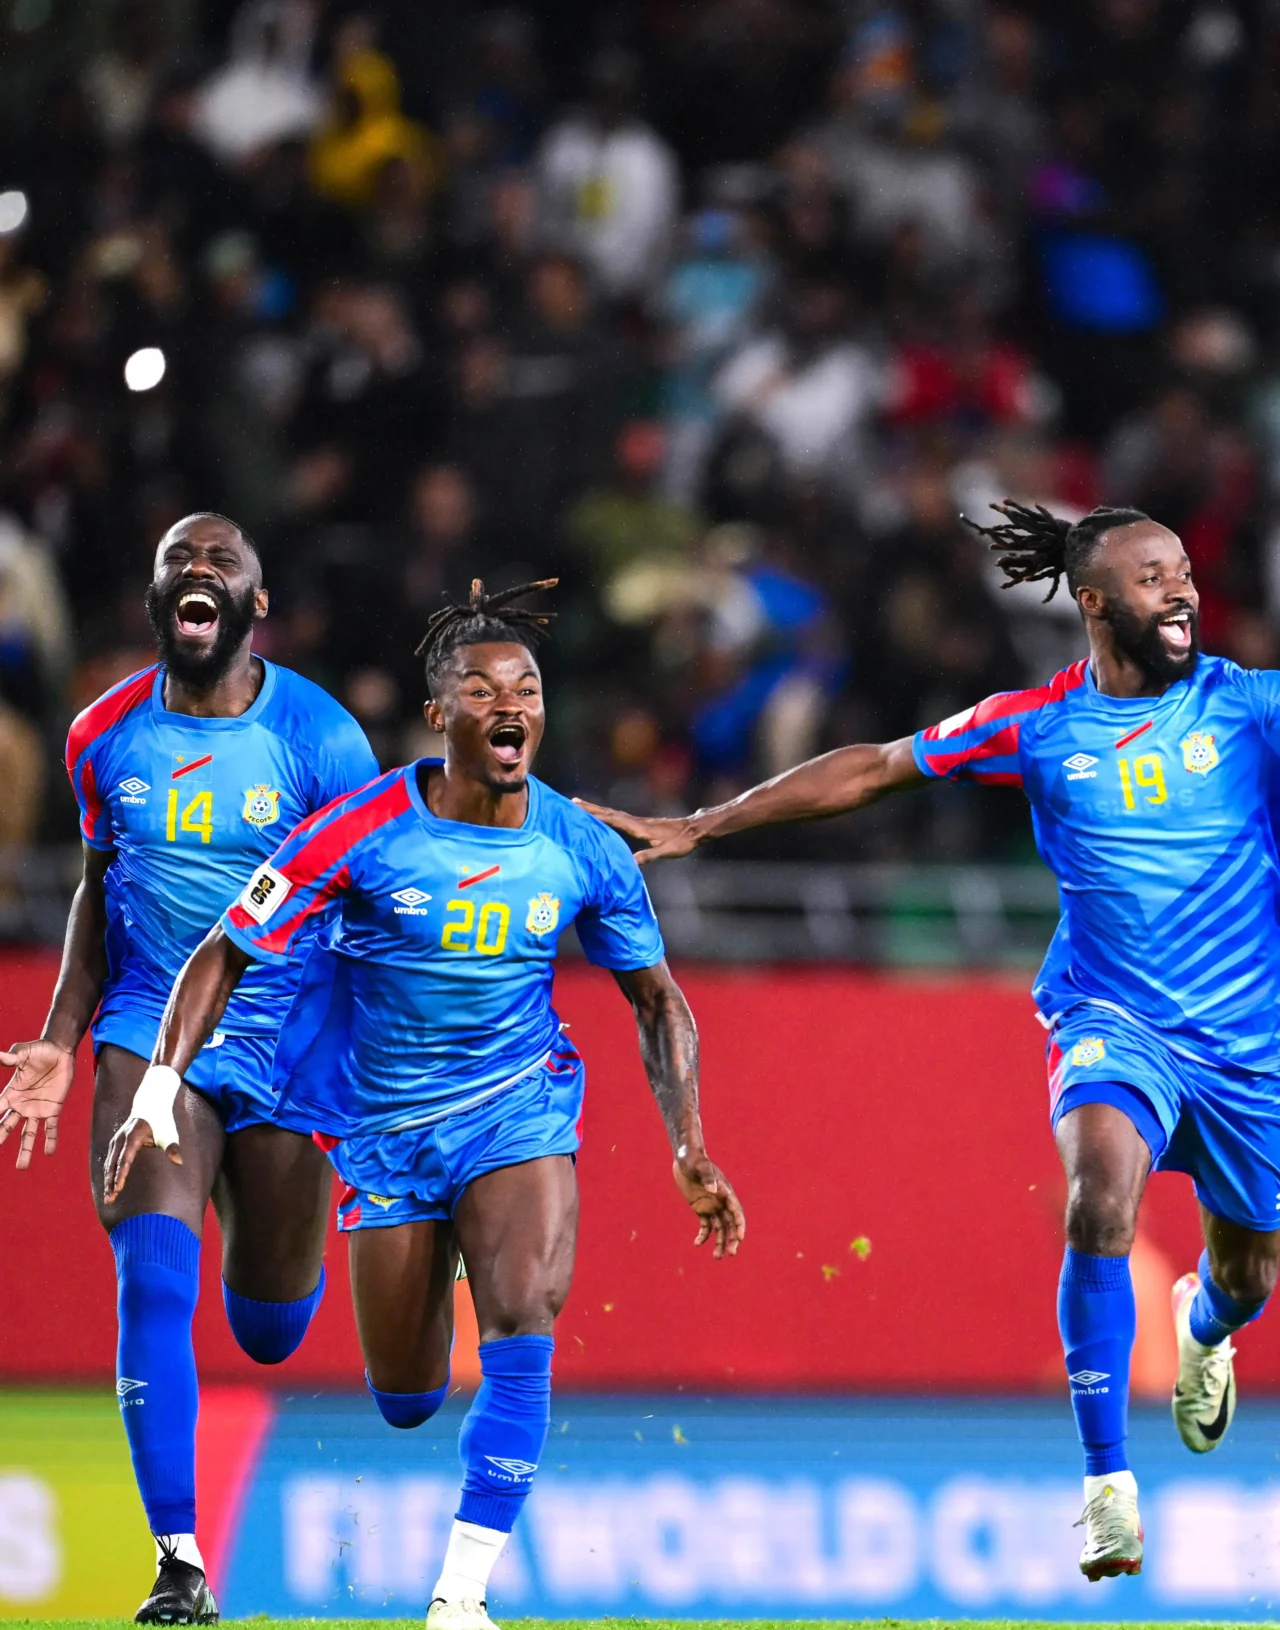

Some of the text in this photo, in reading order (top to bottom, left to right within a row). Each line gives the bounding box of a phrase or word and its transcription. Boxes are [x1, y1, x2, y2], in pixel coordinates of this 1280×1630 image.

[1067, 770, 1097, 781] umbro
[1118, 754, 1168, 810] 19
[120, 795, 146, 805] umbro
[166, 789, 213, 844] 14
[248, 815, 272, 823] FECOFA
[394, 905, 428, 916] umbro
[440, 899, 511, 955] 20
[1072, 1386, 1109, 1396] umbro
[487, 1469, 534, 1483] umbro
